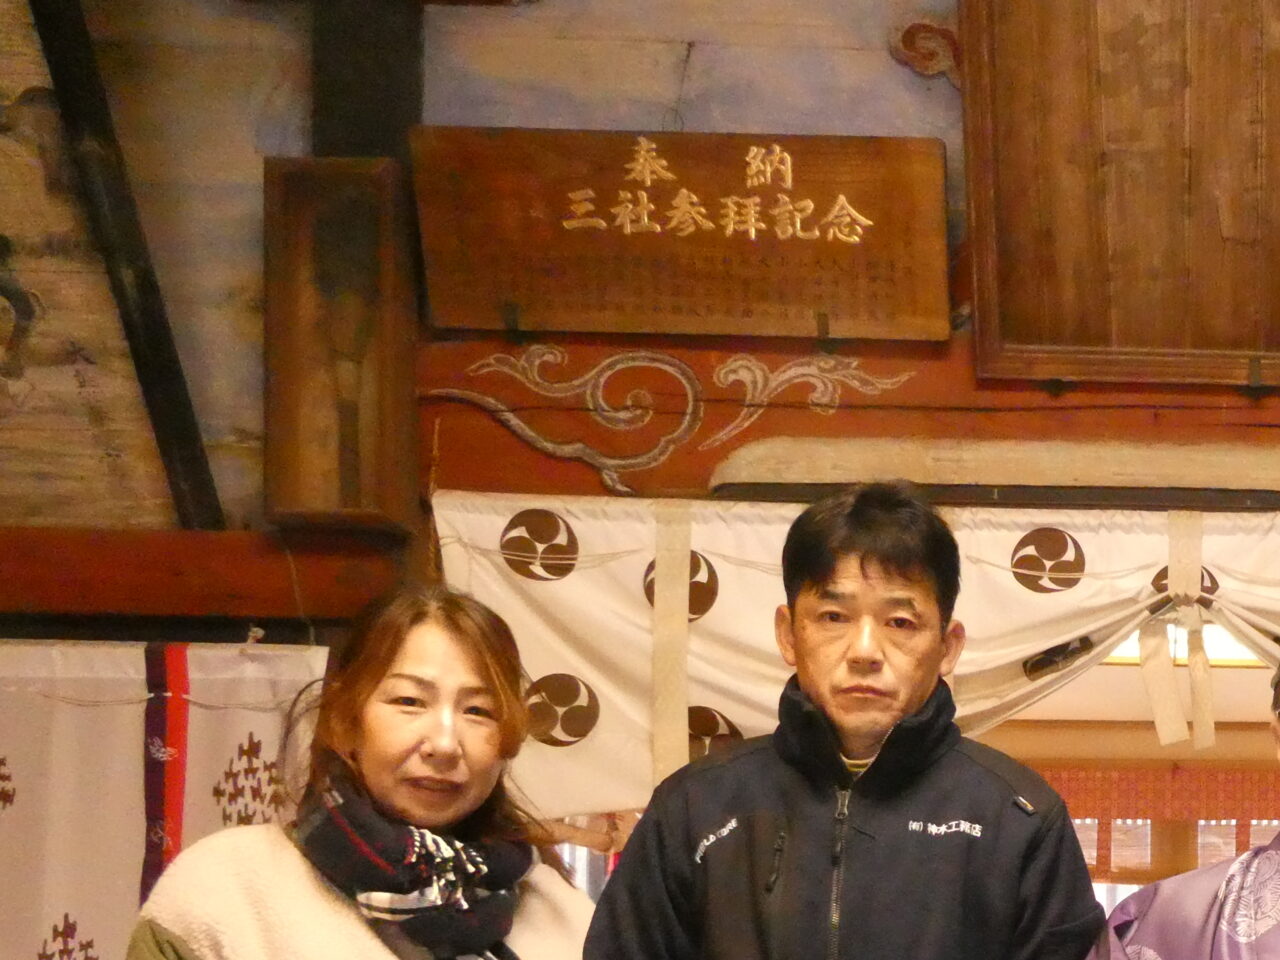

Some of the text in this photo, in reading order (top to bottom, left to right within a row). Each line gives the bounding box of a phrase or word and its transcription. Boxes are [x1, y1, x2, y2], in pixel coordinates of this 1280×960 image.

[623, 136, 792, 190] 奉納
[562, 188, 874, 244] 三社参拝記念
